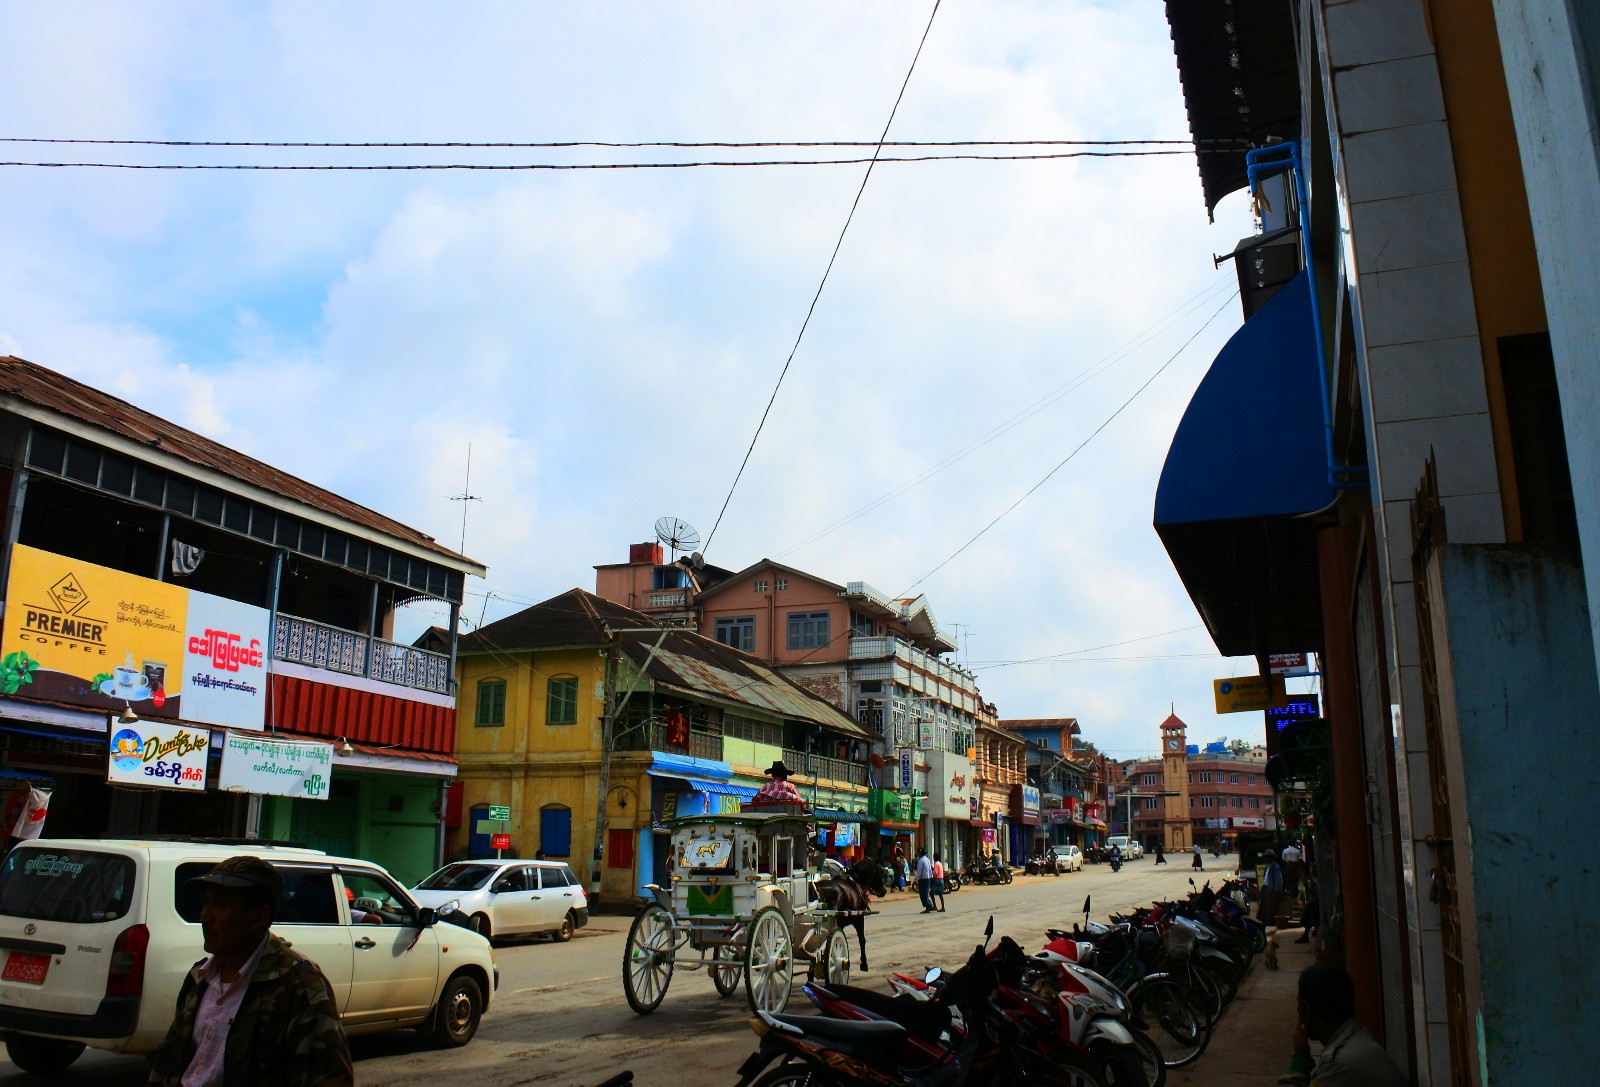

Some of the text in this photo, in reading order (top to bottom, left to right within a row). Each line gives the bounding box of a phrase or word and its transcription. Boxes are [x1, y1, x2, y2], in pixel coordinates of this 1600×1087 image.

[26, 610, 103, 642] PREMIER
[19, 633, 107, 656] COFFEE
[176, 734, 208, 757] Cake
[901, 753, 910, 787] CHERRY
[661, 792, 676, 822] USM
[719, 795, 742, 815] USM
